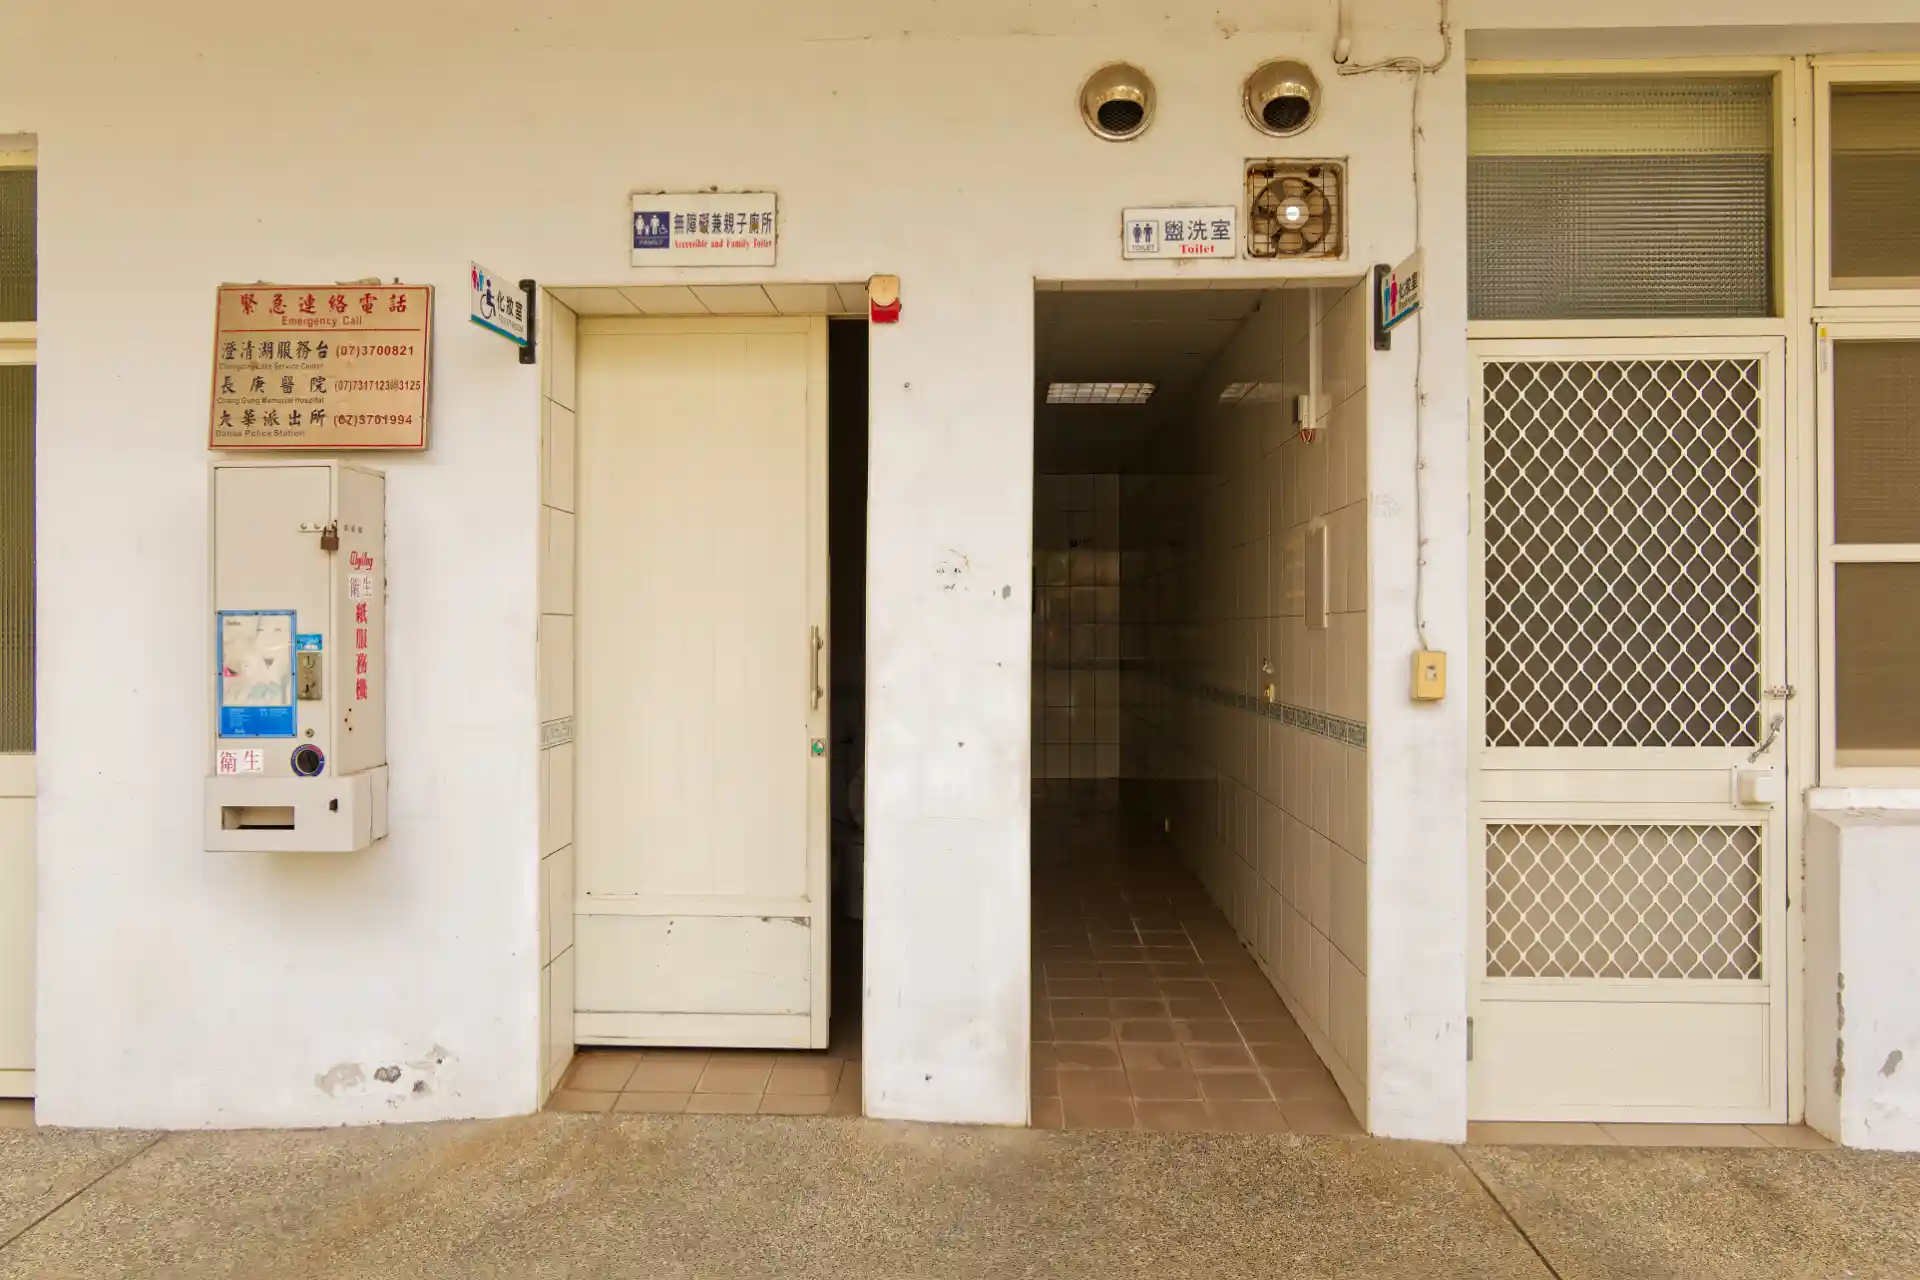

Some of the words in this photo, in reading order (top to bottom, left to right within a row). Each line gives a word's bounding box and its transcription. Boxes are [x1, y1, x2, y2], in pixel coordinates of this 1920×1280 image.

[1164, 219, 1231, 241] 盥洗室
[1180, 244, 1215, 254] Toilet
[240, 293, 407, 315] 緊急連絡電話
[282, 315, 338, 328] Emergency
[342, 315, 363, 326] Call
[222, 339, 329, 360] 澄清湖服務台
[336, 344, 414, 358] (07)3700821
[220, 375, 327, 395] 長庚醫院
[218, 408, 328, 428] 大華派出所
[245, 429, 272, 437] Police
[273, 429, 305, 437] Station
[220, 749, 262, 773] 衛生
